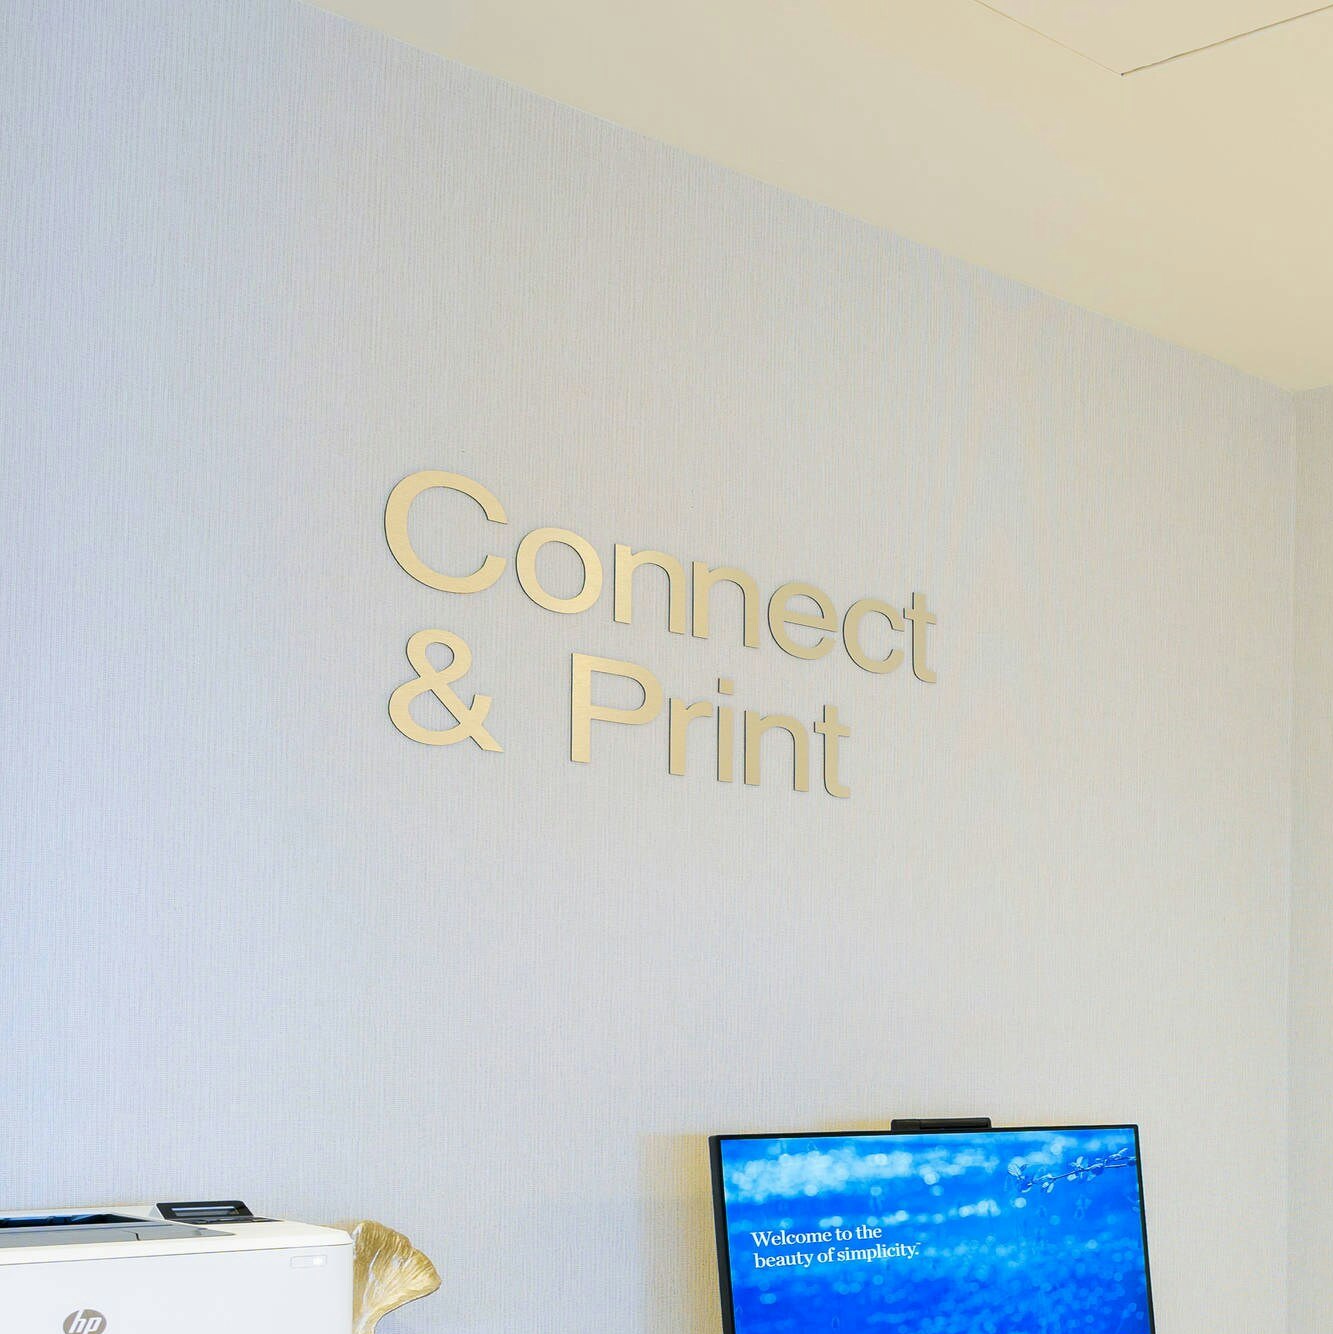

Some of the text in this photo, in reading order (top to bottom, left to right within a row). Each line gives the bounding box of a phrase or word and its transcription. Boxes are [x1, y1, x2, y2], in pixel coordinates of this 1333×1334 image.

[384, 470, 937, 684] Connect
[388, 629, 851, 799] & Print
[750, 1225, 882, 1247] Welcome to the
[753, 1251, 813, 1268] beauty
[817, 1247, 835, 1263] of
